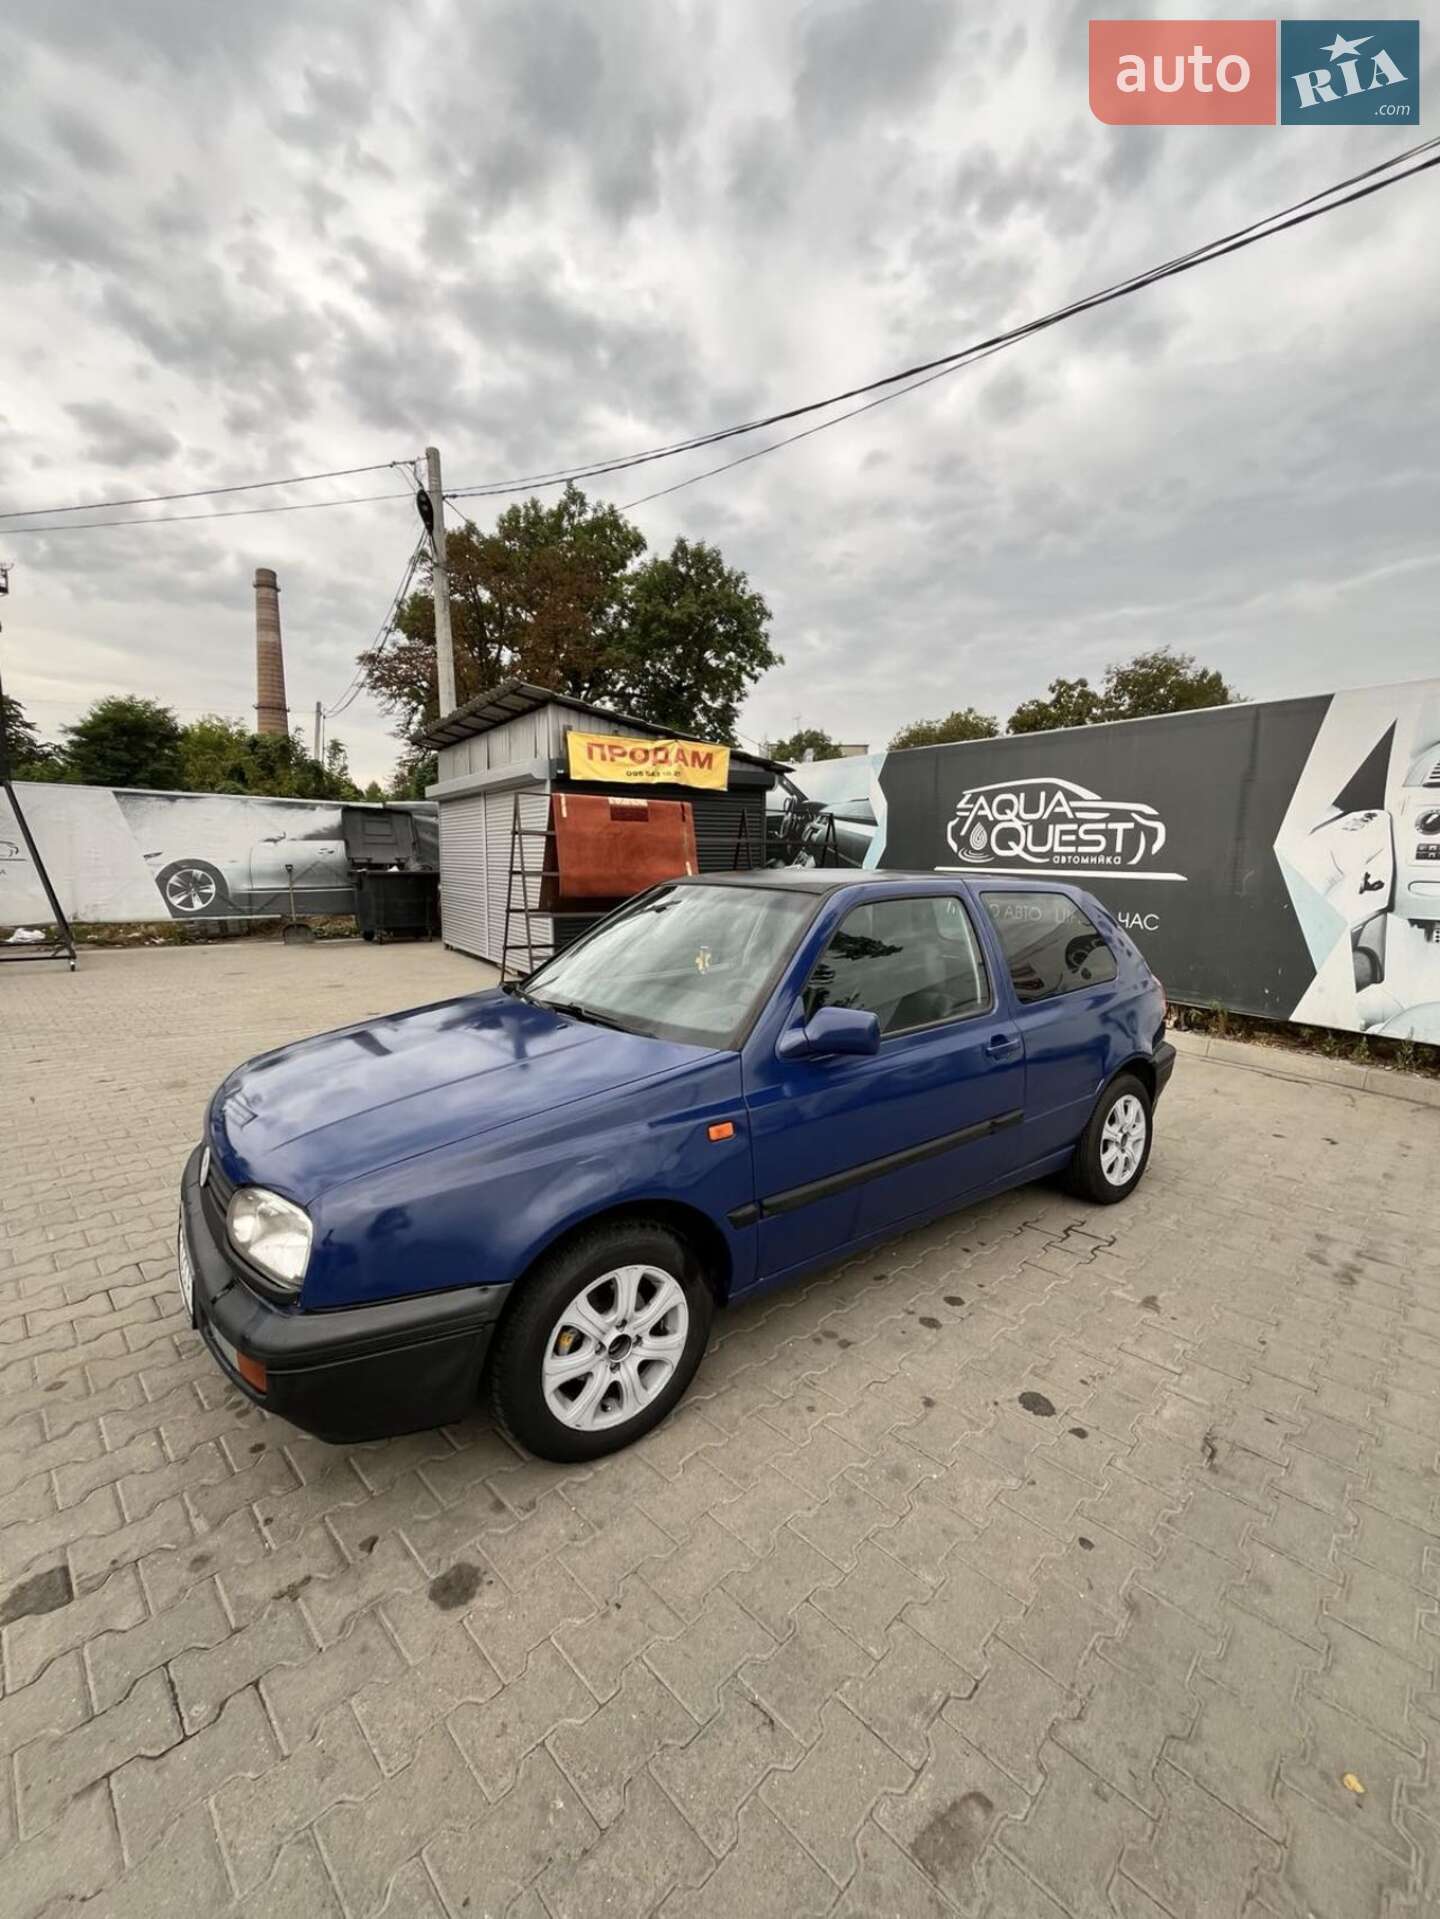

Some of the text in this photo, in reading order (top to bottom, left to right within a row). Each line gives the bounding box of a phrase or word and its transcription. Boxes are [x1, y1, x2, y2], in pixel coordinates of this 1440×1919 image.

[587, 743, 714, 770] ПРОДАМ
[961, 791, 1074, 836] AQUA
[989, 821, 1136, 863] QUEST
[1052, 855, 1122, 865] автомийка
[1118, 913, 1160, 932] ЧАС
